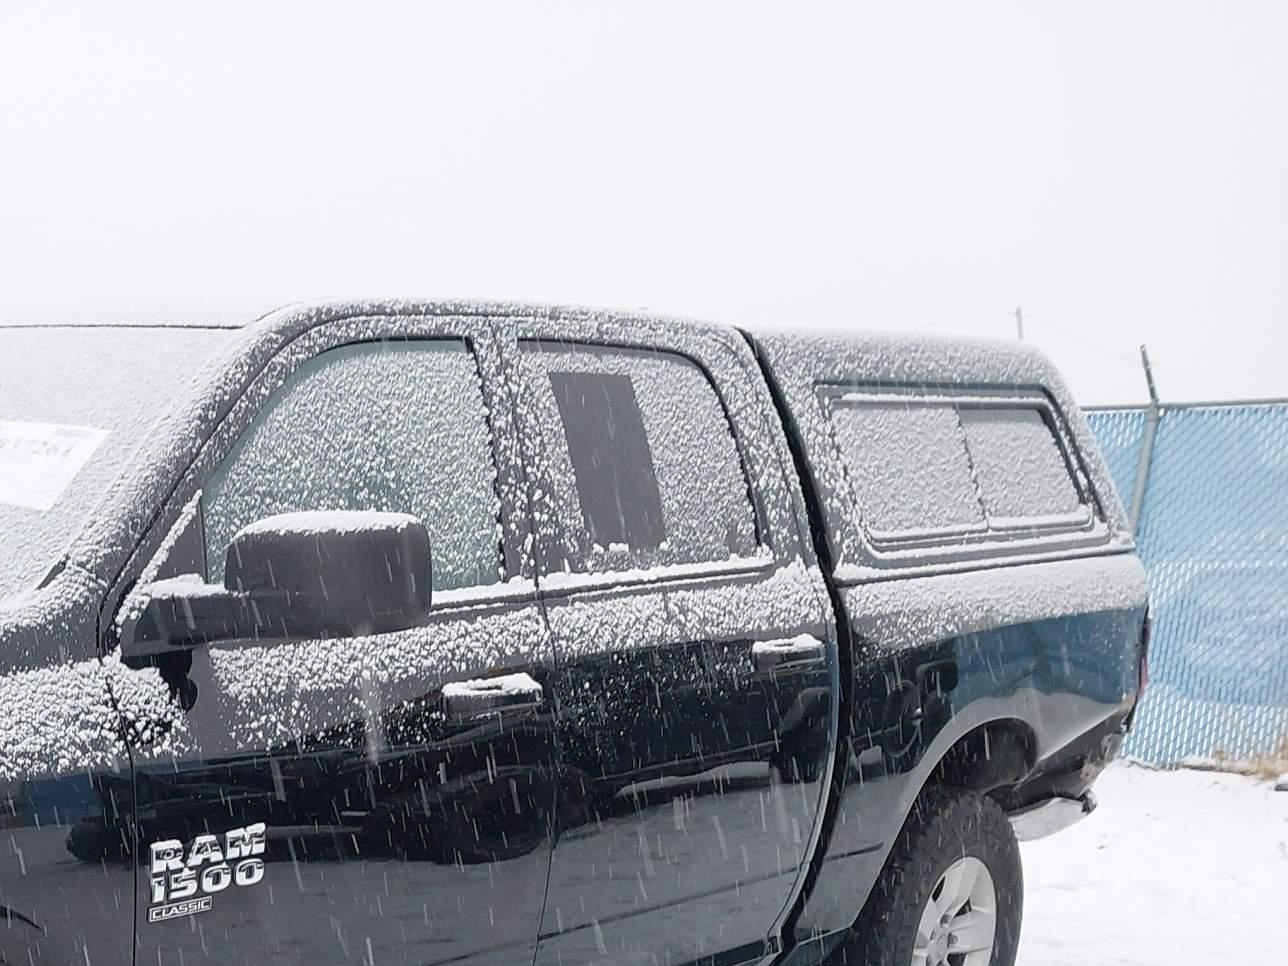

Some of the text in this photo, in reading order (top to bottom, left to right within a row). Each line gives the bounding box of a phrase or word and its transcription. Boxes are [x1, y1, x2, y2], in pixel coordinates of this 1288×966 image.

[150, 822, 266, 874] RAM
[150, 858, 265, 904] 1500
[151, 898, 211, 920] CLASSIC
